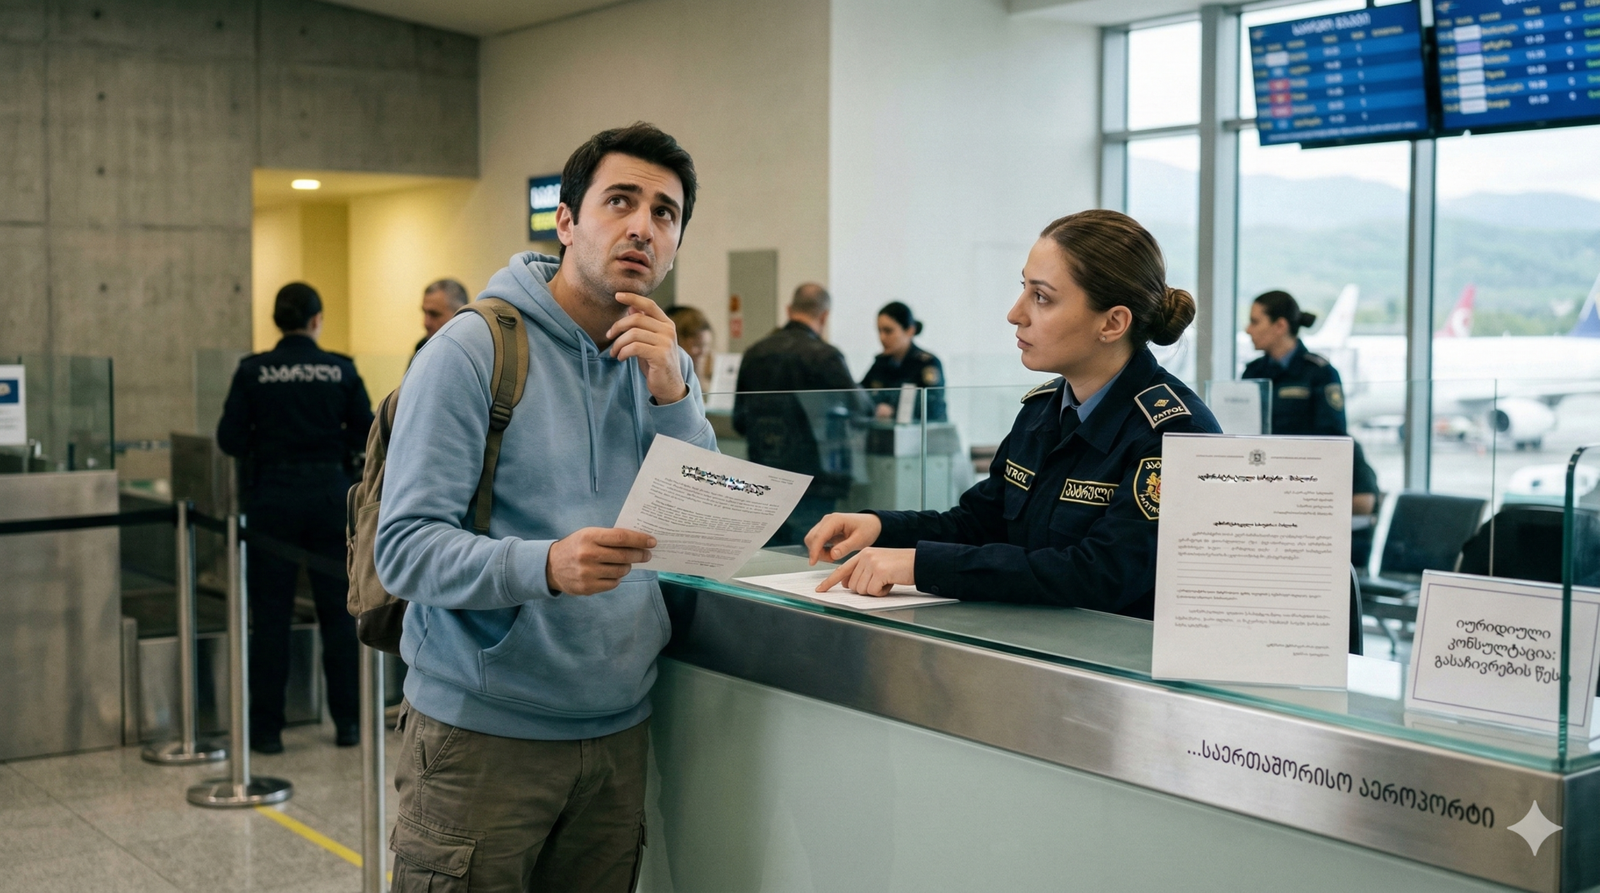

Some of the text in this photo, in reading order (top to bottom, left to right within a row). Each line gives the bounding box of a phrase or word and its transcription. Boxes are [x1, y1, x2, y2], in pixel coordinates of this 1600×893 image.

[1065, 483, 1114, 502] პატრული
[1456, 619, 1551, 642] იურიდიული
[1447, 636, 1557, 661] კონსულტაცია:
[1434, 653, 1532, 677] გასაჩივრების
[1358, 777, 1495, 829] აეროპორტი
